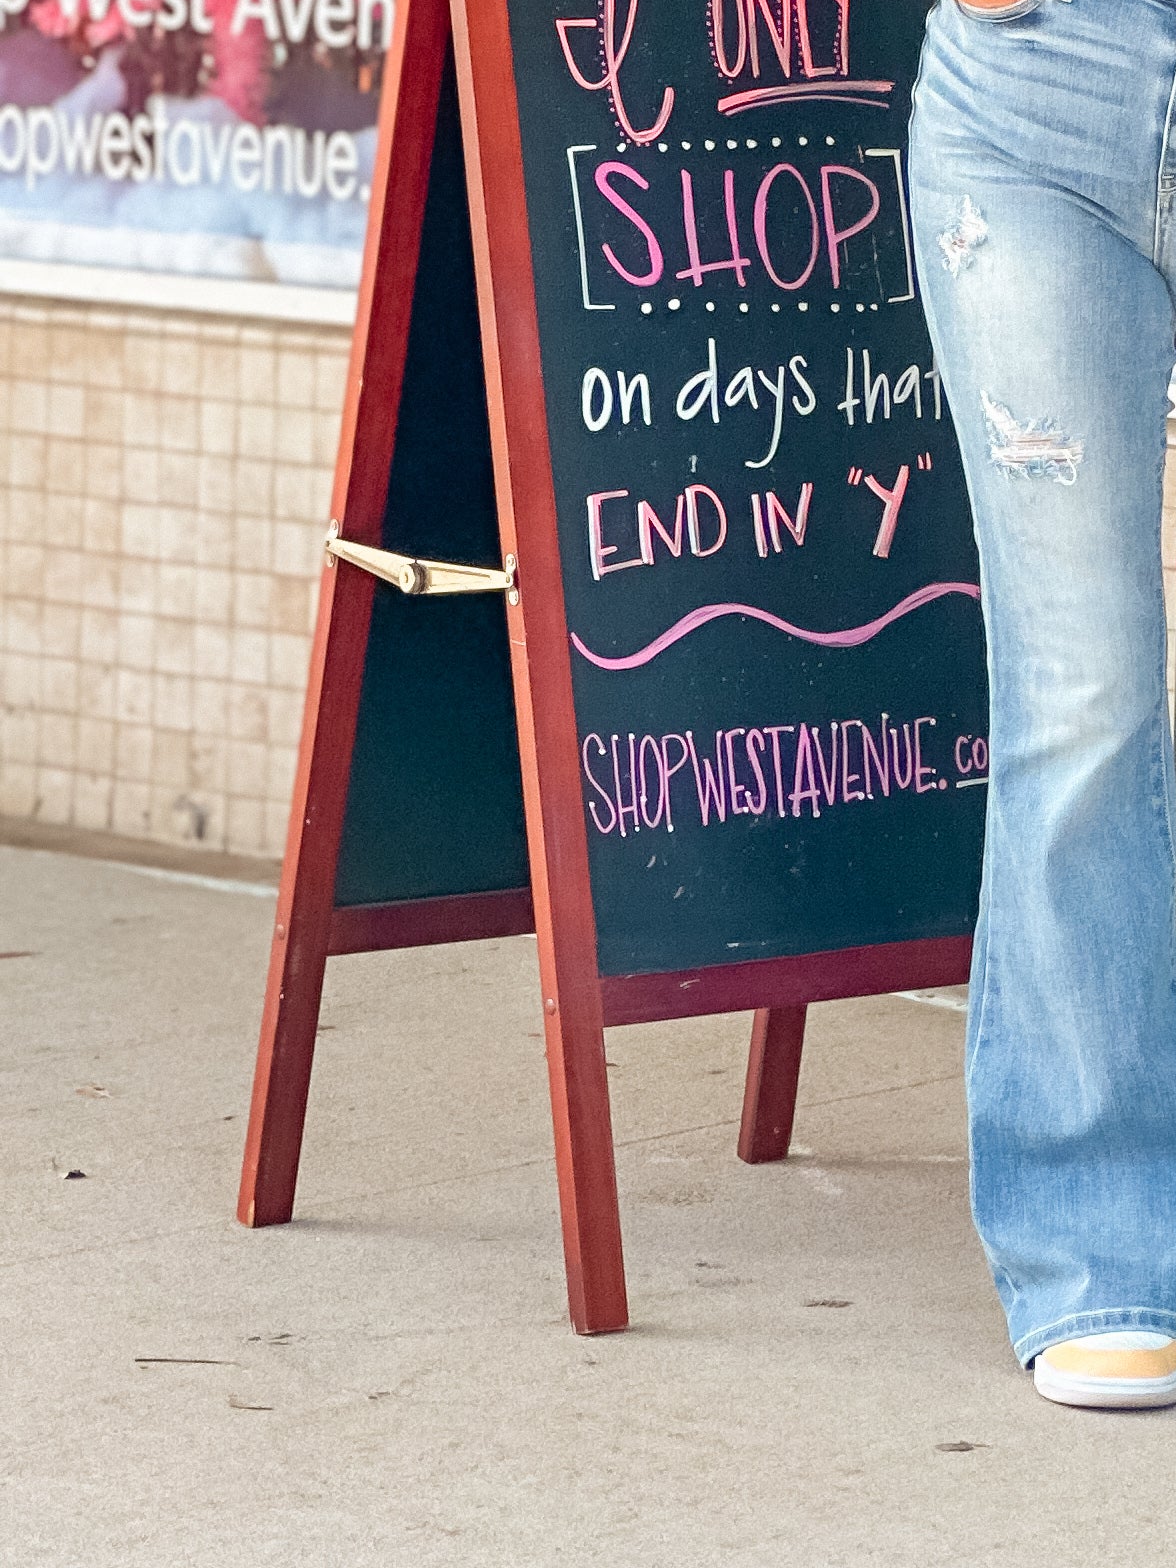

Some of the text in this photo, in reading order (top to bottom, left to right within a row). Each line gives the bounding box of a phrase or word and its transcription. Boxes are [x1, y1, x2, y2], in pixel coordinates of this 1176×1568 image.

[594, 160, 880, 290] SHOP
[581, 337, 942, 468] on days that
[586, 483, 728, 581] END
[752, 481, 814, 560] IN
